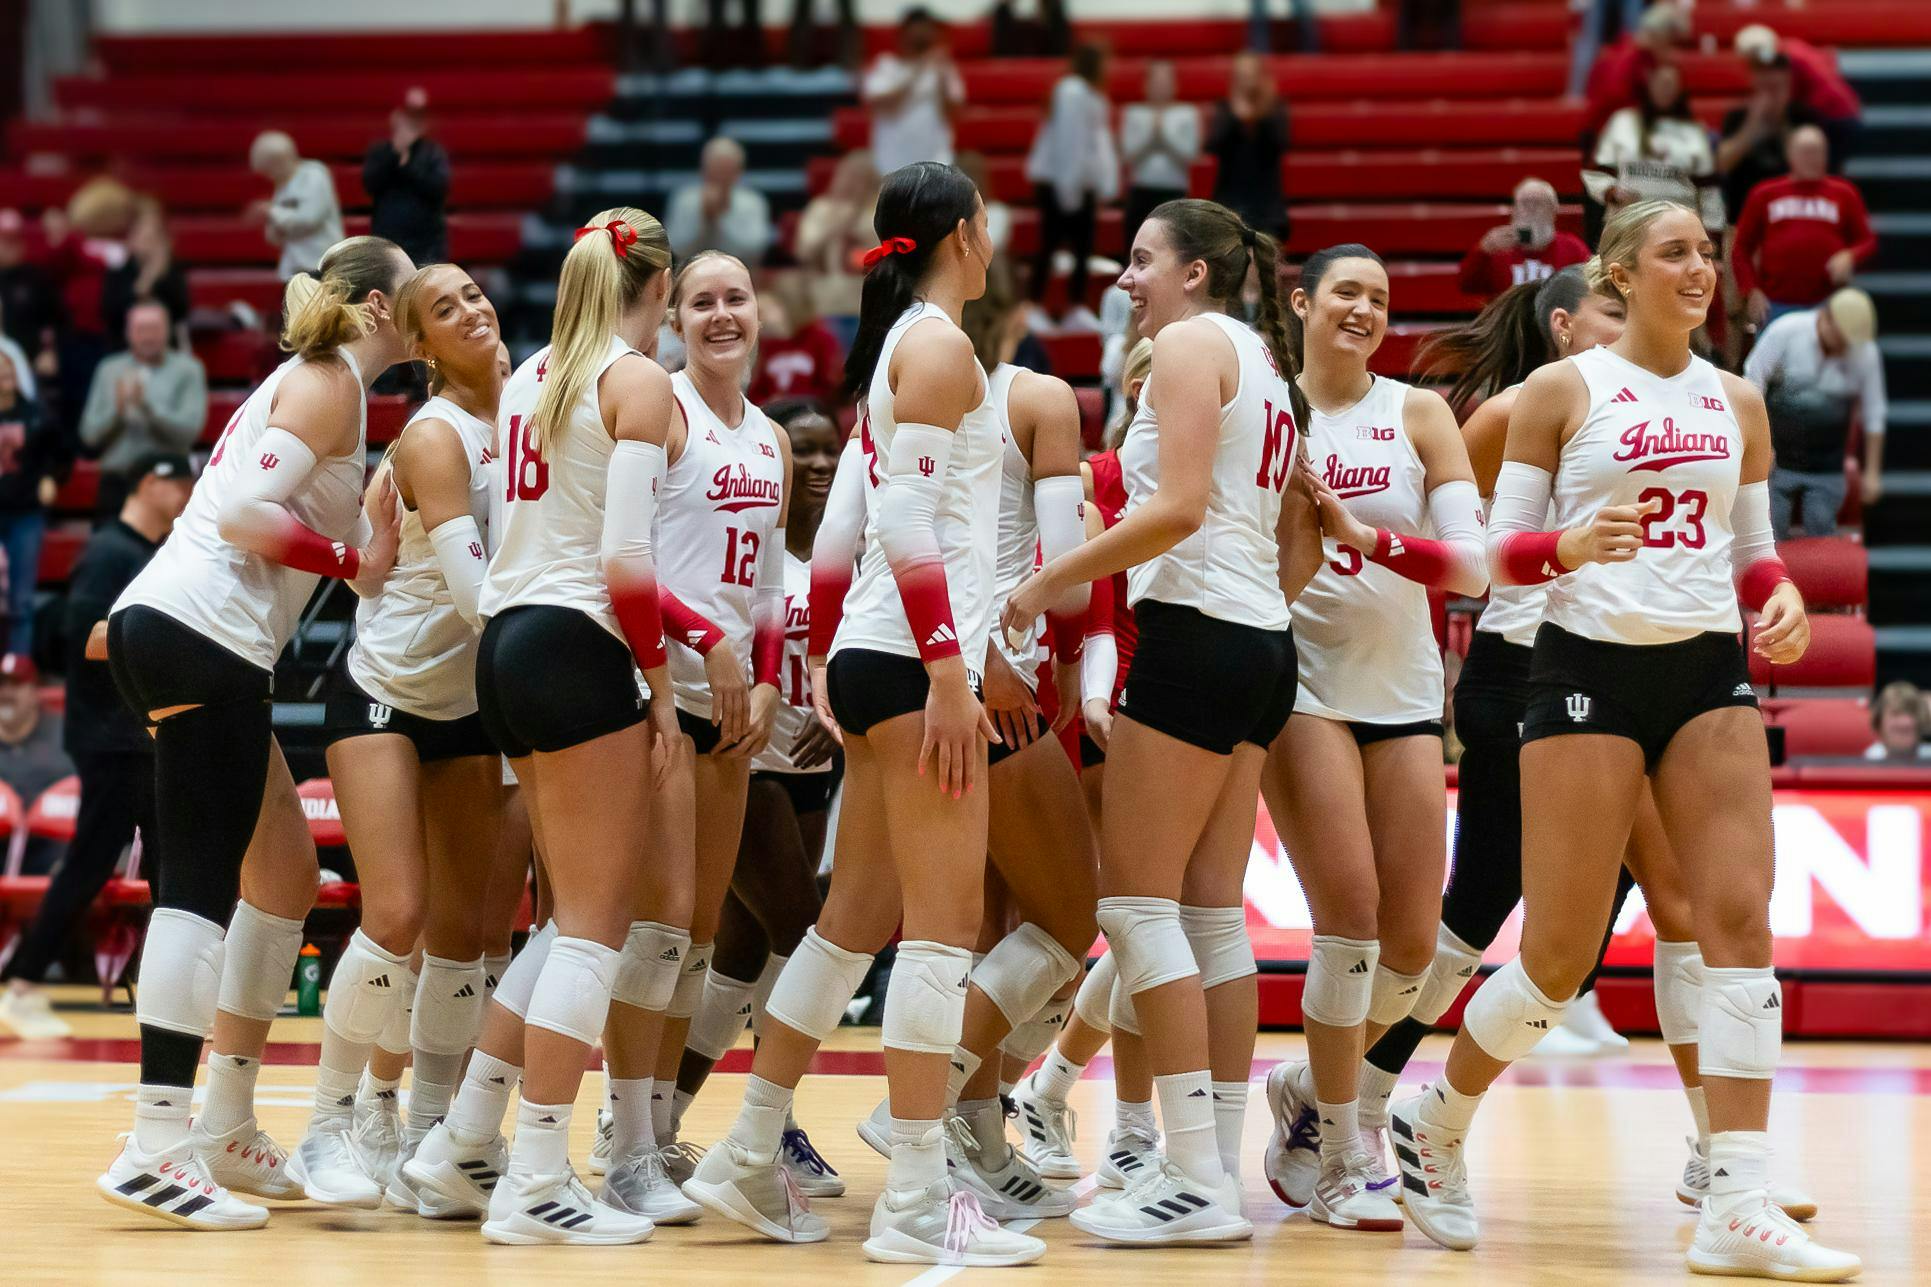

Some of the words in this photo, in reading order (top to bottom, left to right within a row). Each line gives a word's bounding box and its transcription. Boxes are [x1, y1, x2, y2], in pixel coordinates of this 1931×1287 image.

[506, 414, 550, 503] 18
[1256, 399, 1296, 494] 10
[1613, 417, 1730, 471] Indiana
[706, 463, 780, 510] Indiana
[1638, 487, 1708, 550] 23
[720, 526, 760, 588] 12
